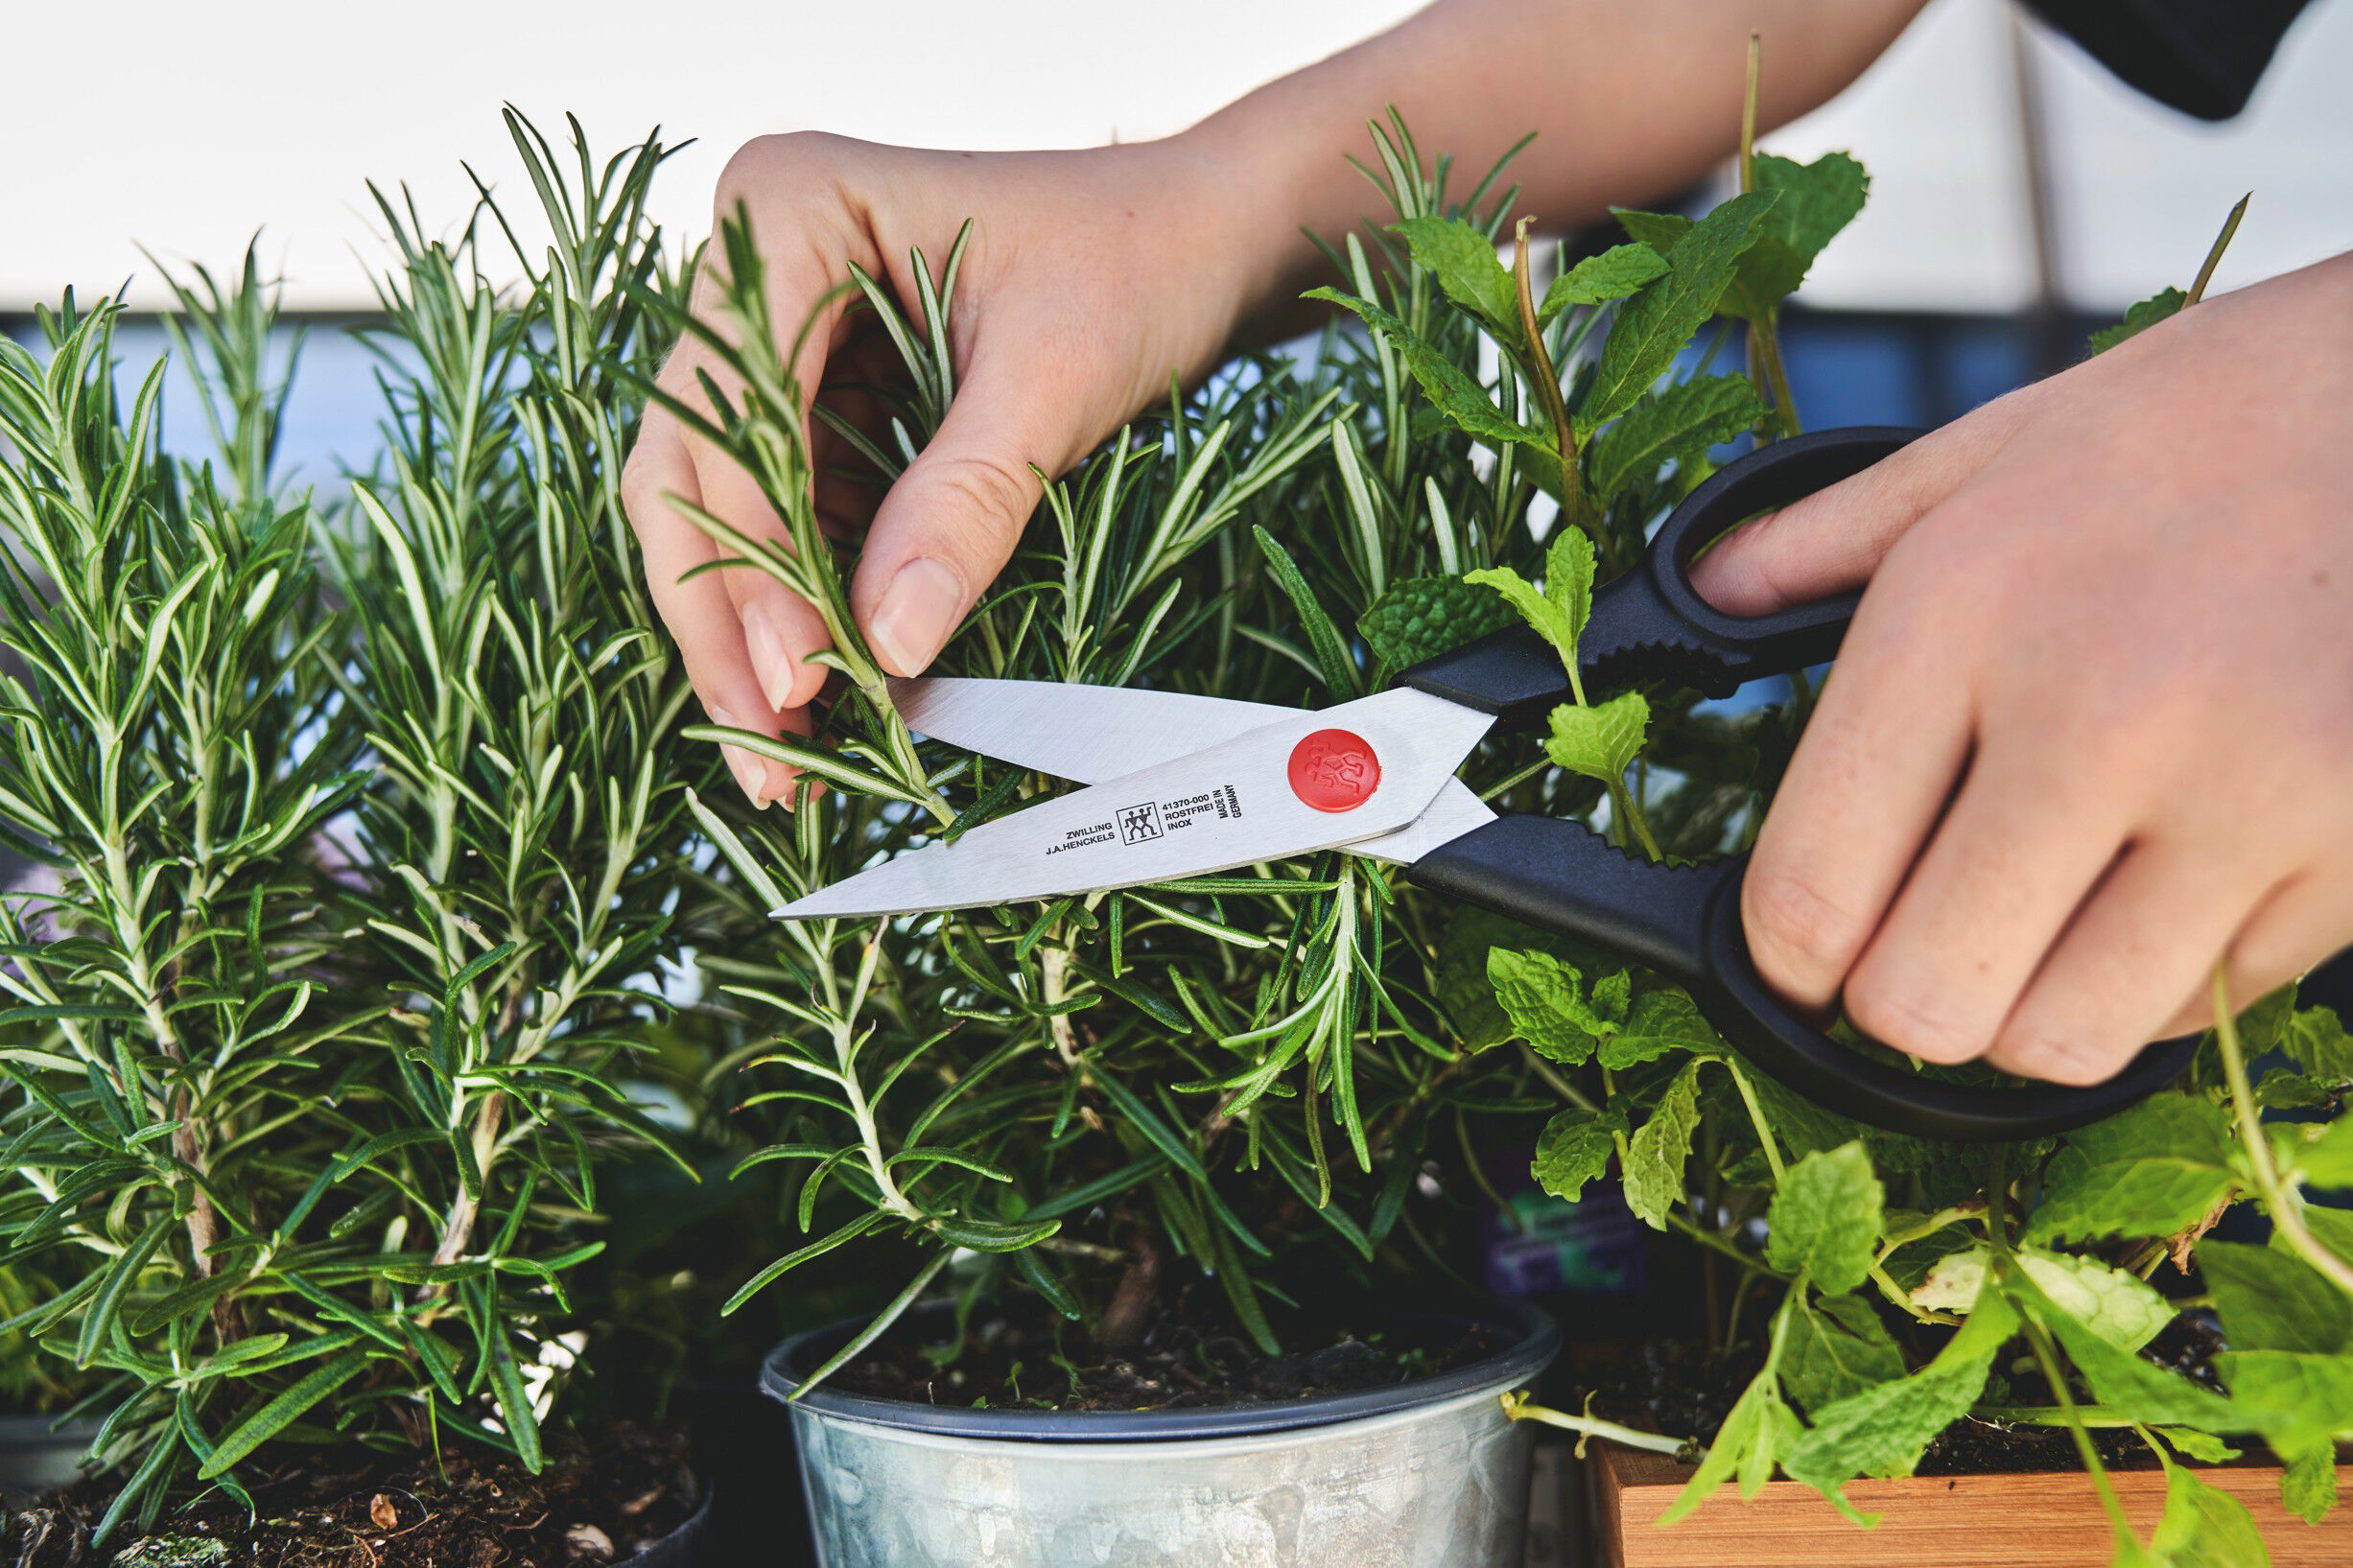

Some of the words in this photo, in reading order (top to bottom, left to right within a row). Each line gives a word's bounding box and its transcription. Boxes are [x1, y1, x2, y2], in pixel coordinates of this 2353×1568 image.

[1162, 794, 1210, 810] 41370-000
[1212, 789, 1223, 798] IN
[1224, 784, 1242, 818] GERMANY
[1165, 803, 1214, 821] ROSTFREI
[1214, 798, 1229, 819] MADE
[1066, 822, 1113, 839] ZWILLING
[1167, 818, 1192, 831] INOX
[1046, 831, 1116, 855] J.A.HENCKELS
